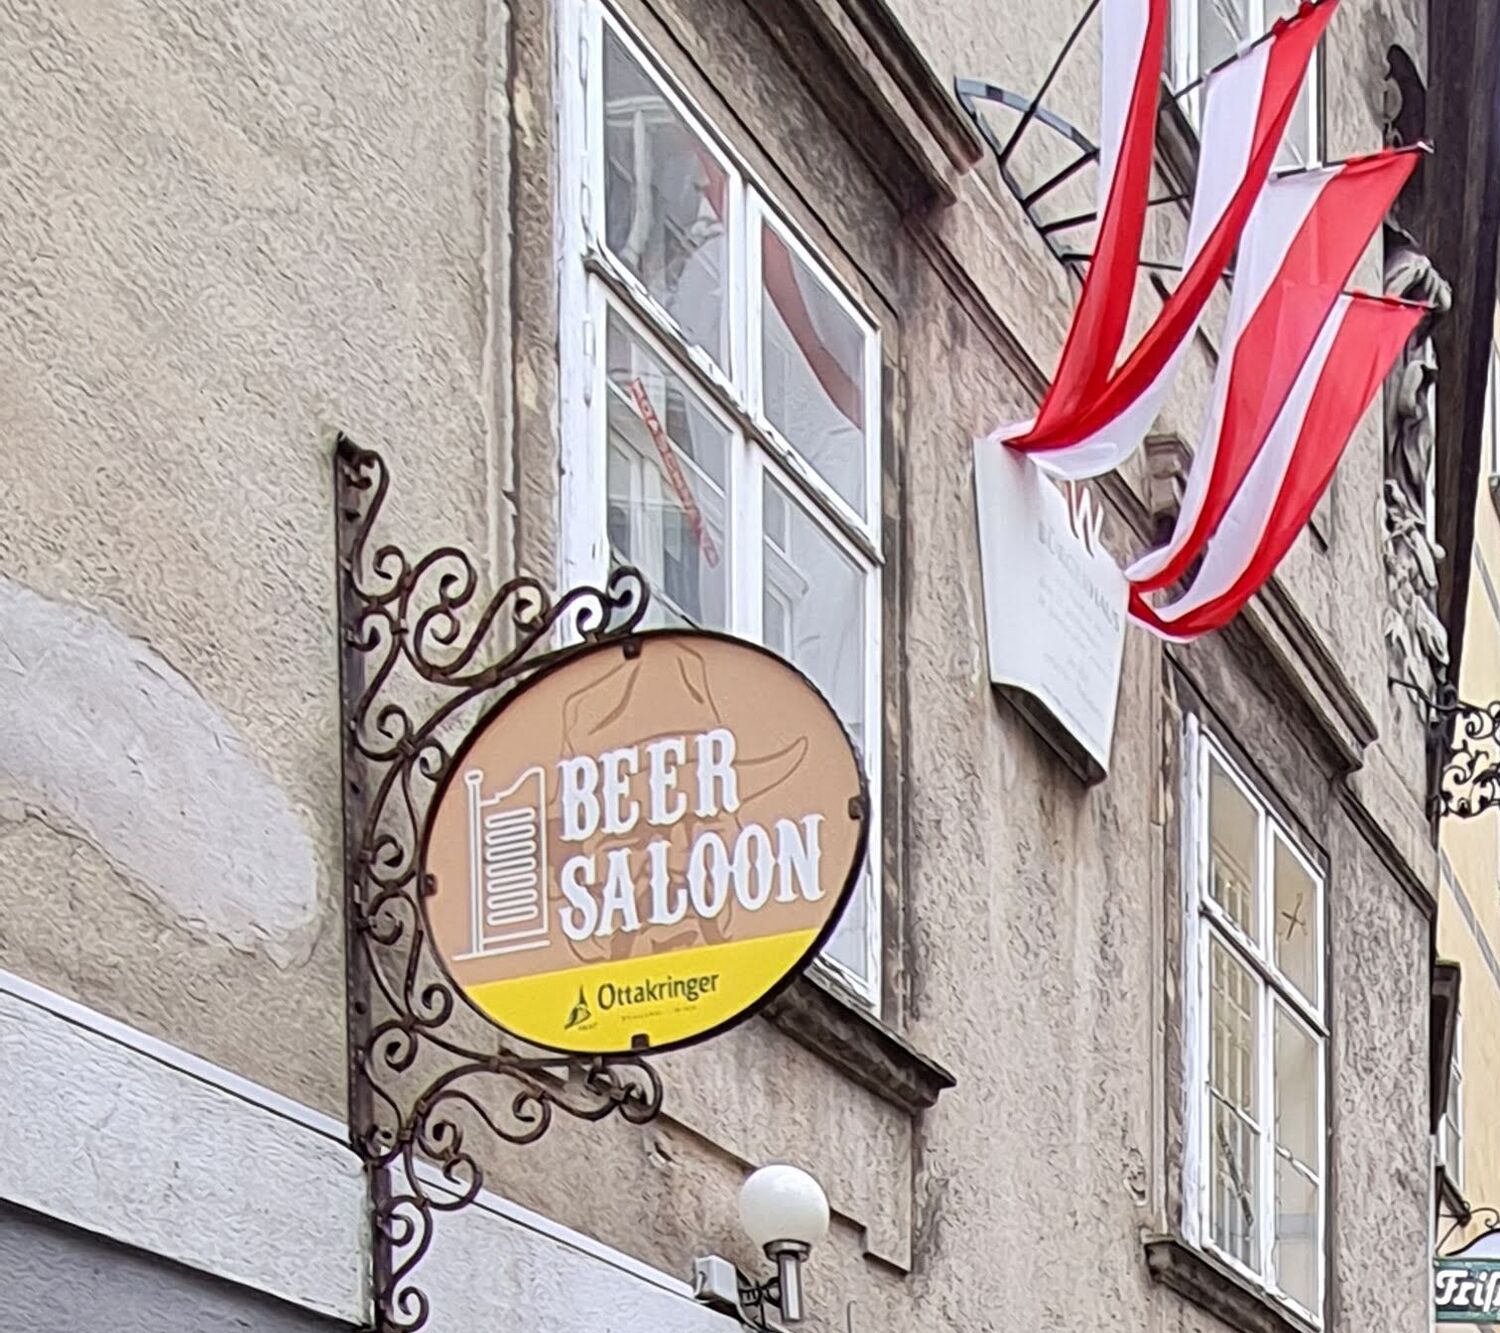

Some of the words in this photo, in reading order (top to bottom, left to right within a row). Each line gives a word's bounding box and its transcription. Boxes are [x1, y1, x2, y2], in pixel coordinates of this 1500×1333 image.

[556, 728, 740, 843] BEER
[558, 813, 827, 942] SALOON
[597, 974, 720, 1011] Ottakringer
